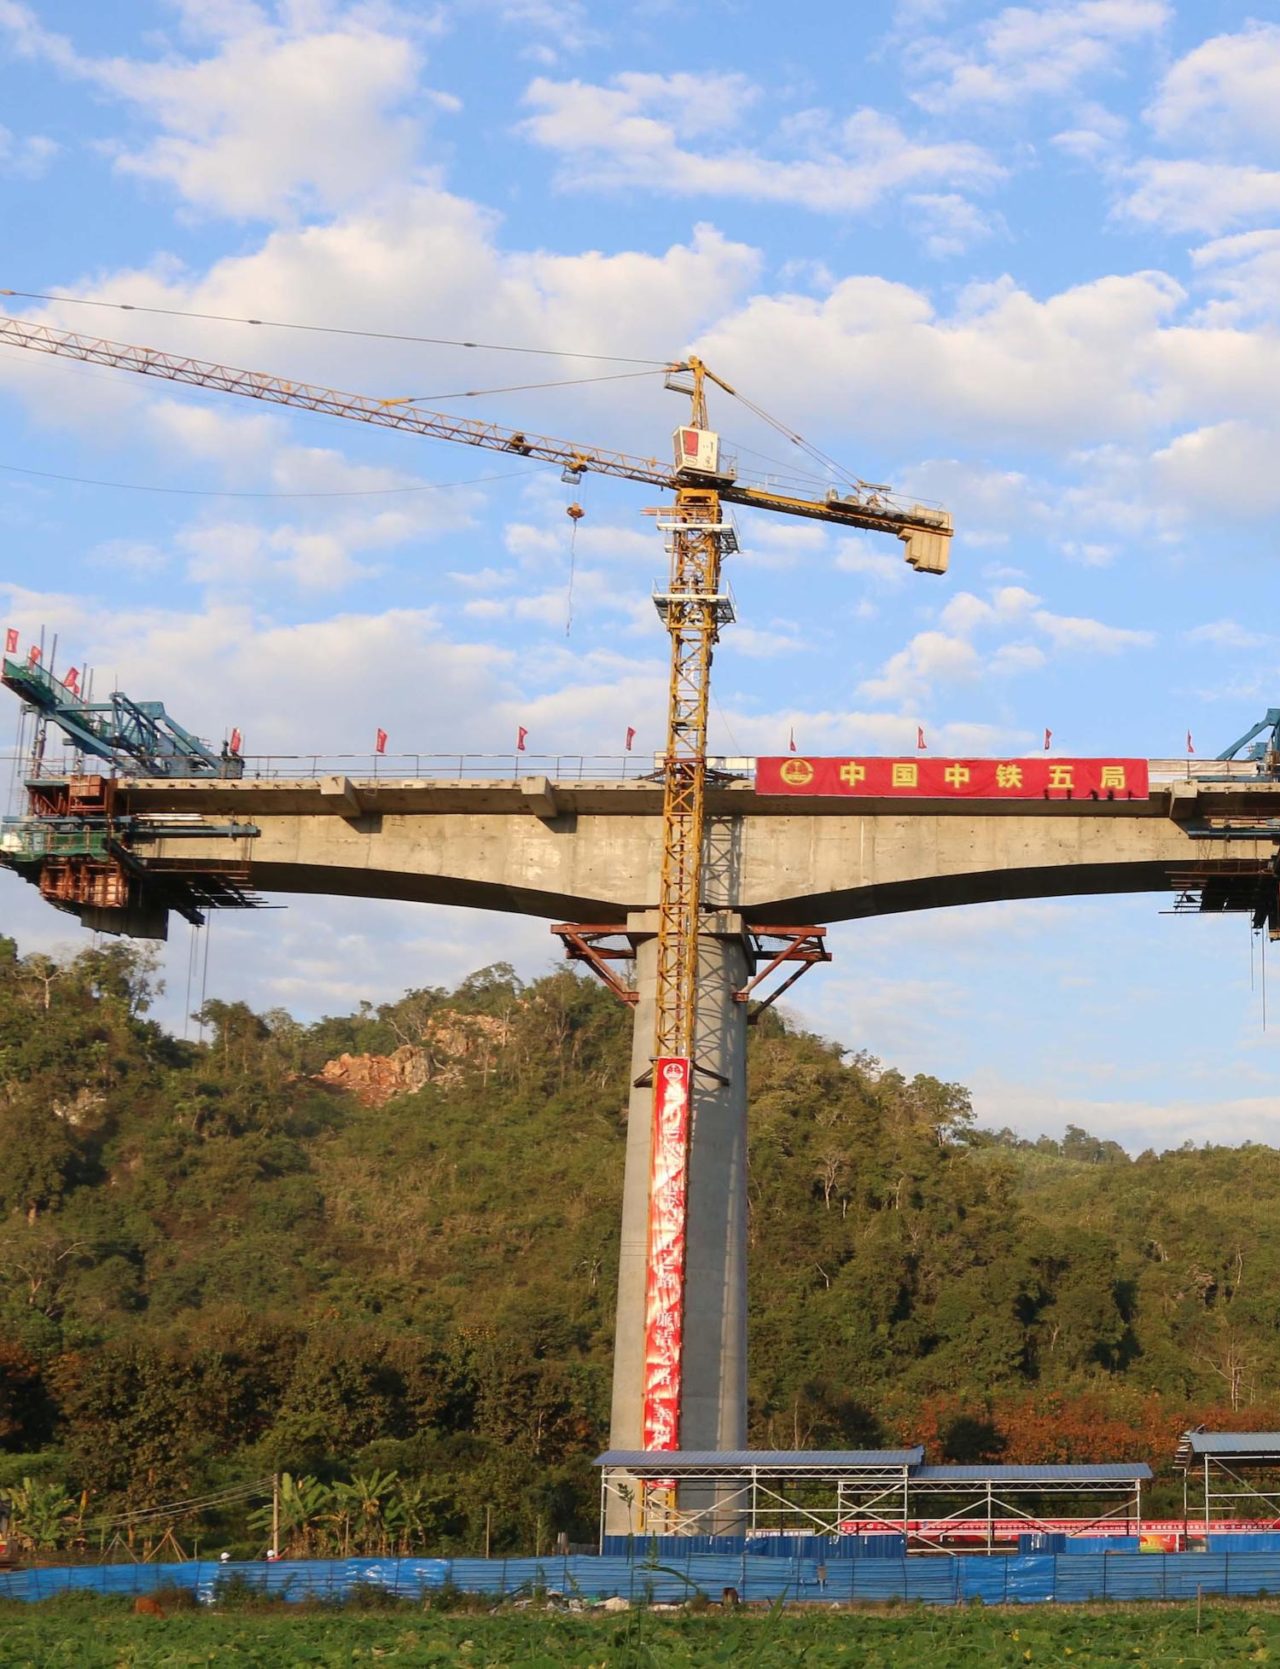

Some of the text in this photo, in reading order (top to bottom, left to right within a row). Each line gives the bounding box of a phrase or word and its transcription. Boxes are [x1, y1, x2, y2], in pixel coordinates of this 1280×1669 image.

[840, 761, 1125, 789] 中国中铁五局
